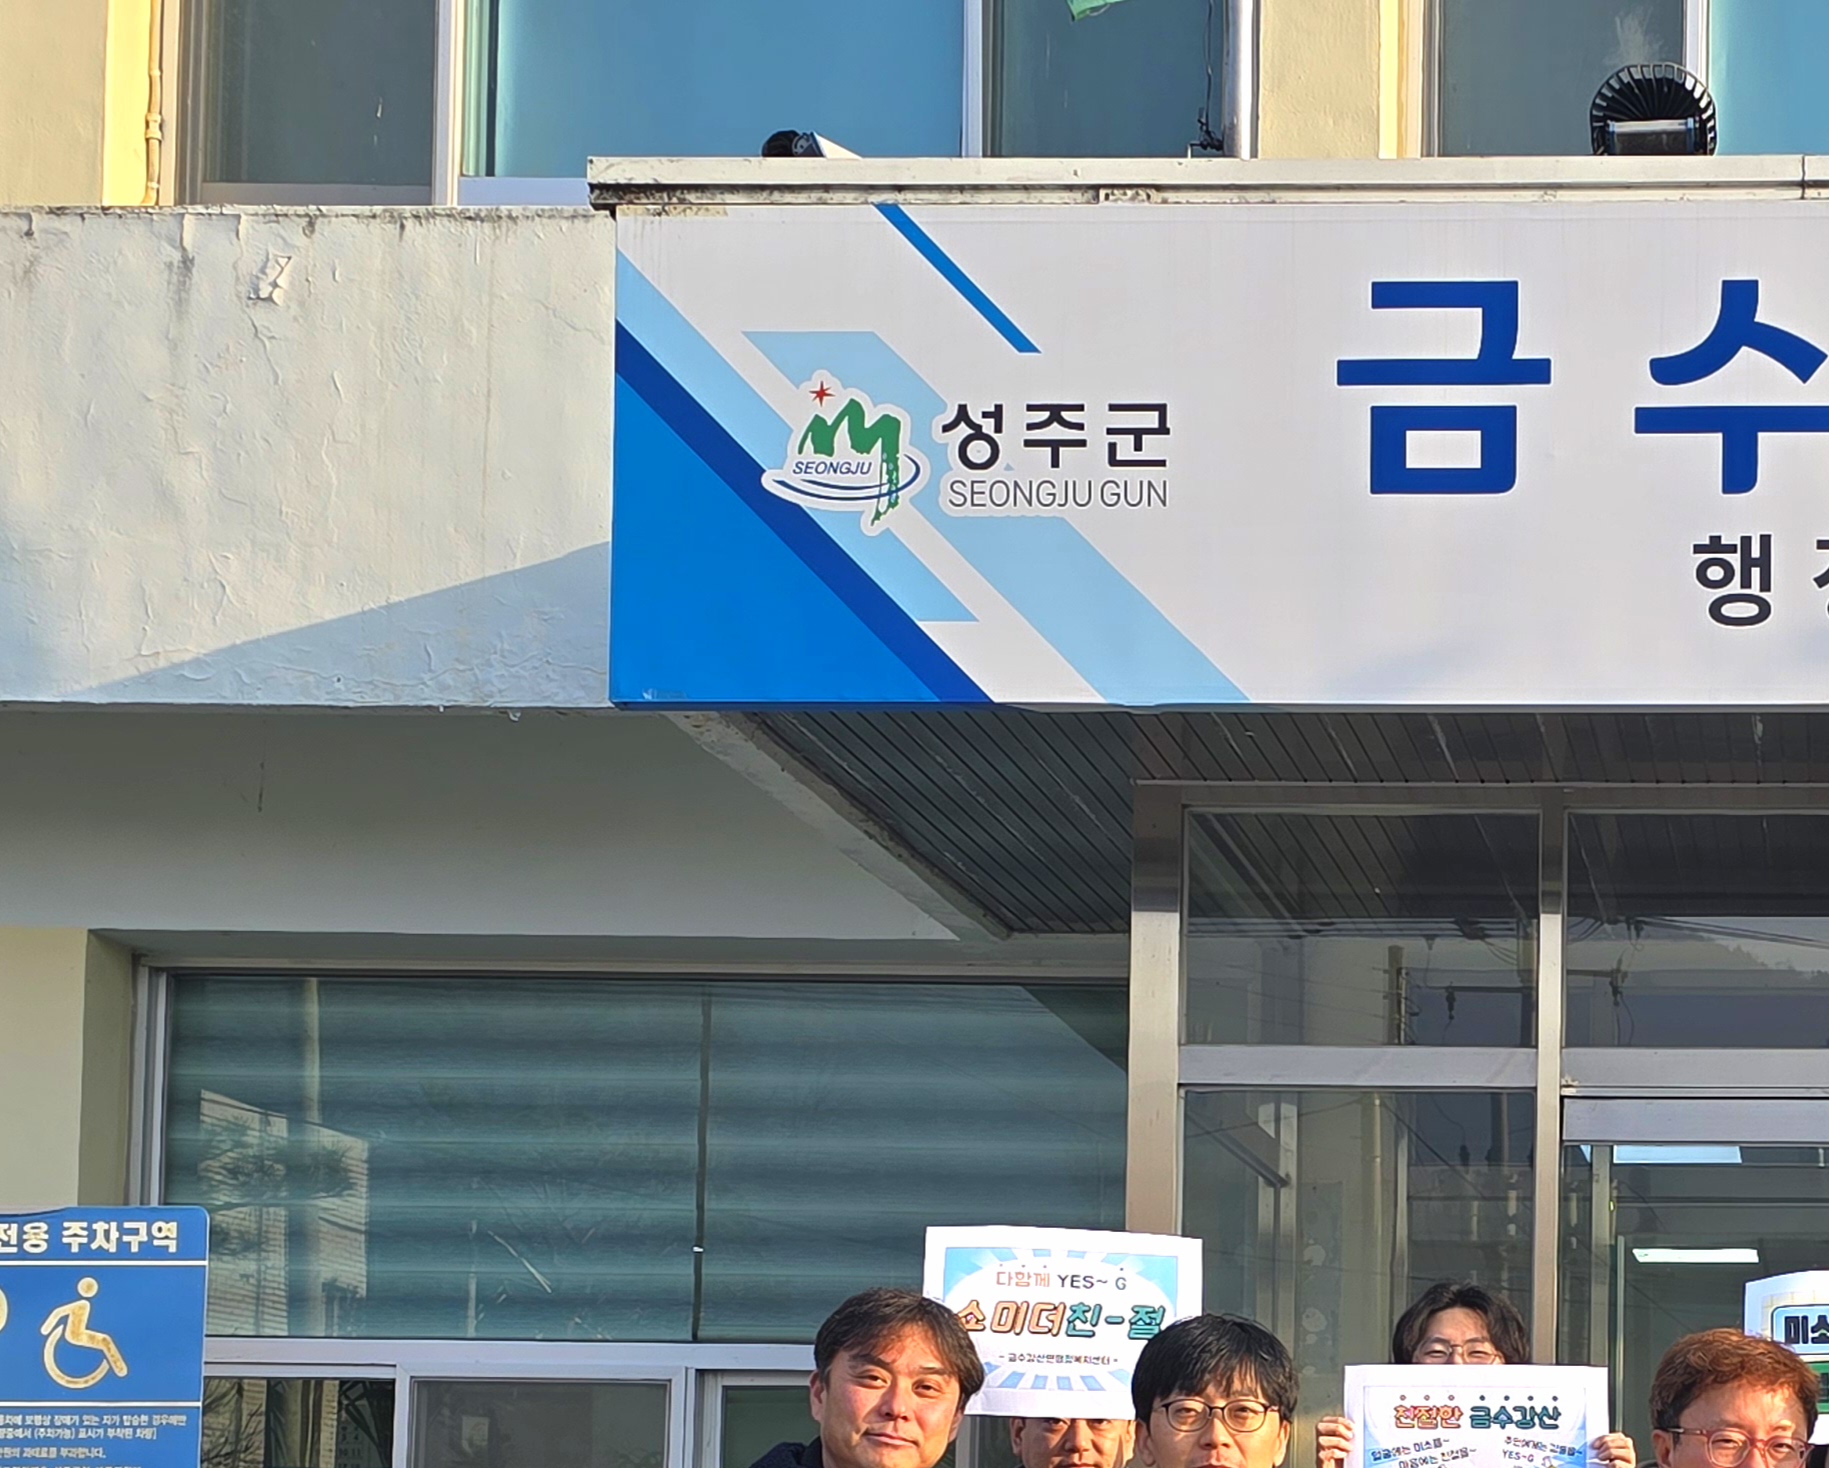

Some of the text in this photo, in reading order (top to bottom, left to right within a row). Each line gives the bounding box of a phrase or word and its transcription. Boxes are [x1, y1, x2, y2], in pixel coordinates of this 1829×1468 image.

[942, 403, 1170, 470] 성주군
[792, 461, 872, 475] SEONGJU
[949, 480, 1168, 508] SEONGJU GUN
[61, 1221, 177, 1253] 주차구역
[996, 1271, 1050, 1287] 다함께
[1115, 1277, 1127, 1290] G
[1394, 1404, 1562, 1430] 친절한 금수강산
